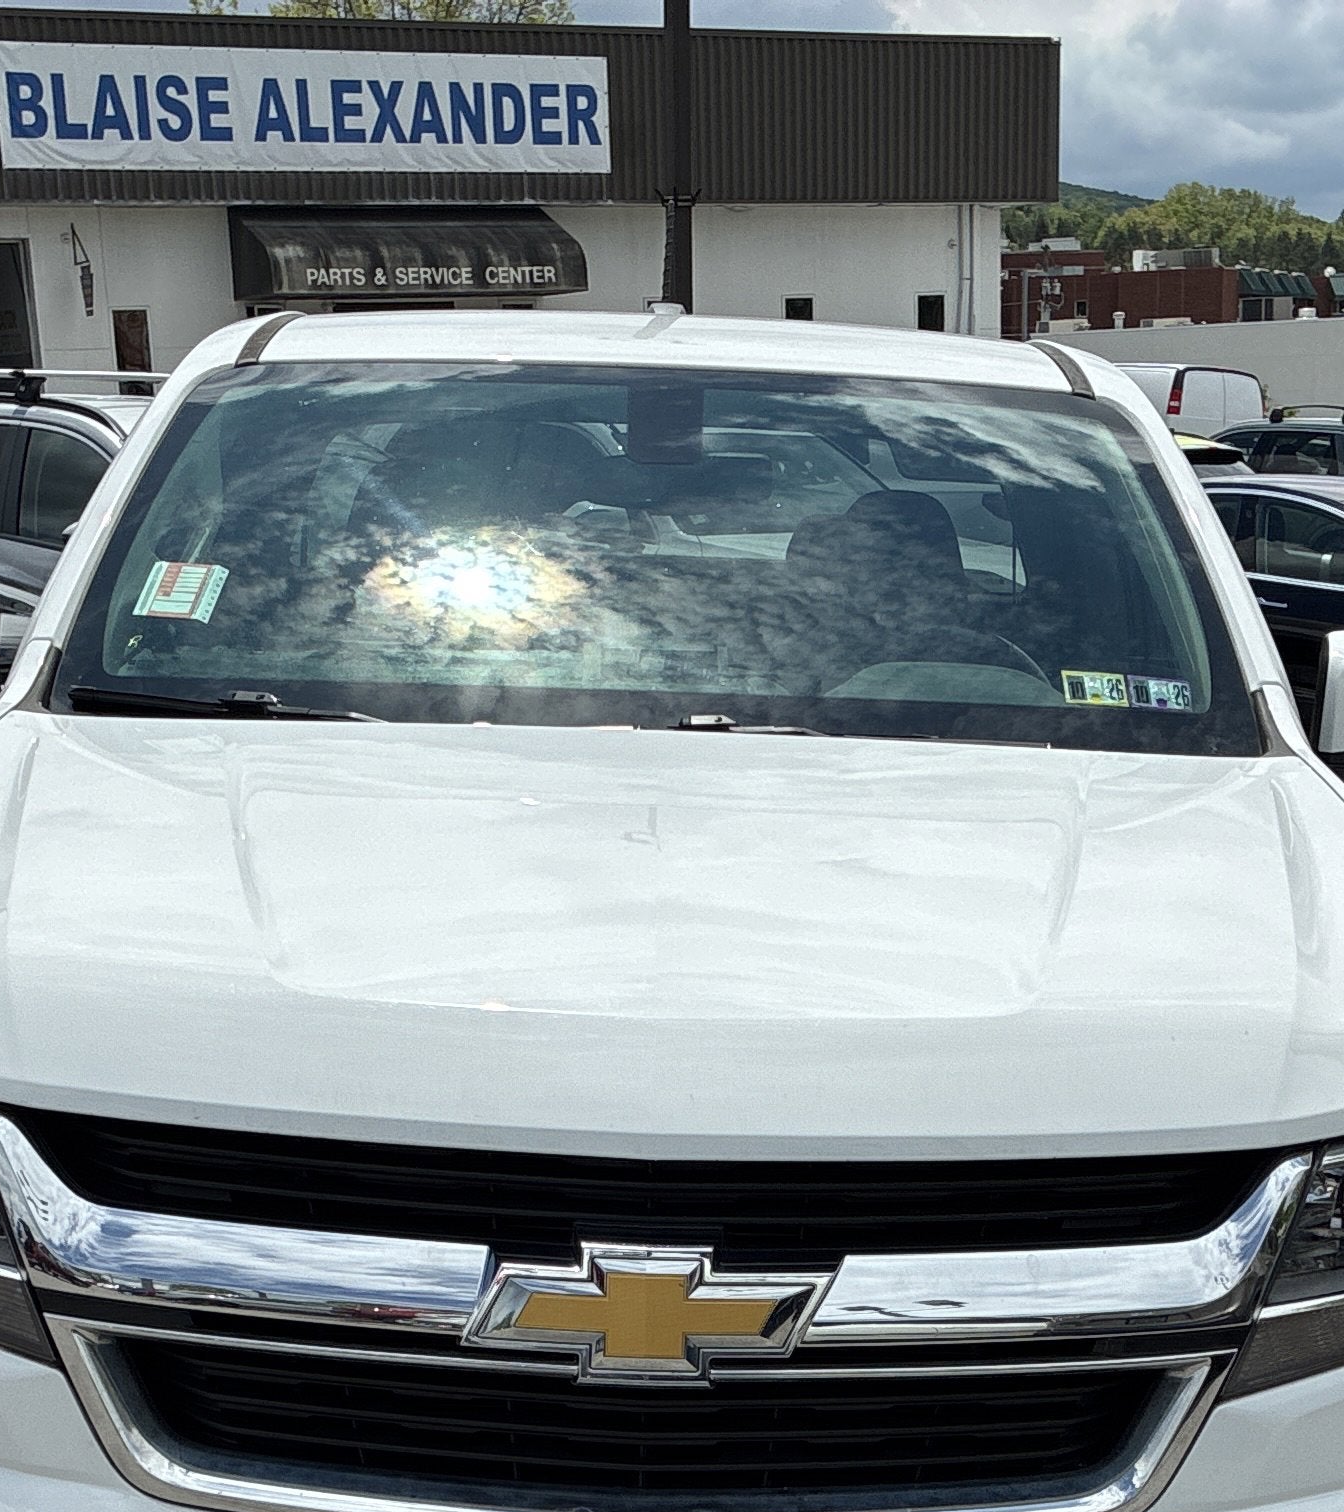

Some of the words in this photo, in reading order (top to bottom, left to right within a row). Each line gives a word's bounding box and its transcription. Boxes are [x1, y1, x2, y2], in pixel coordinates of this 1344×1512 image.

[4, 71, 233, 142] BLAISE
[255, 78, 603, 146] ALEXANDER
[306, 267, 366, 286] PARTS
[373, 268, 387, 286] &
[395, 267, 474, 285] SERVICE
[485, 265, 556, 284] CENTER
[1068, 681, 1087, 700] 10
[1107, 678, 1125, 701] 26
[1133, 685, 1150, 704] 10
[1172, 684, 1190, 707] 26
